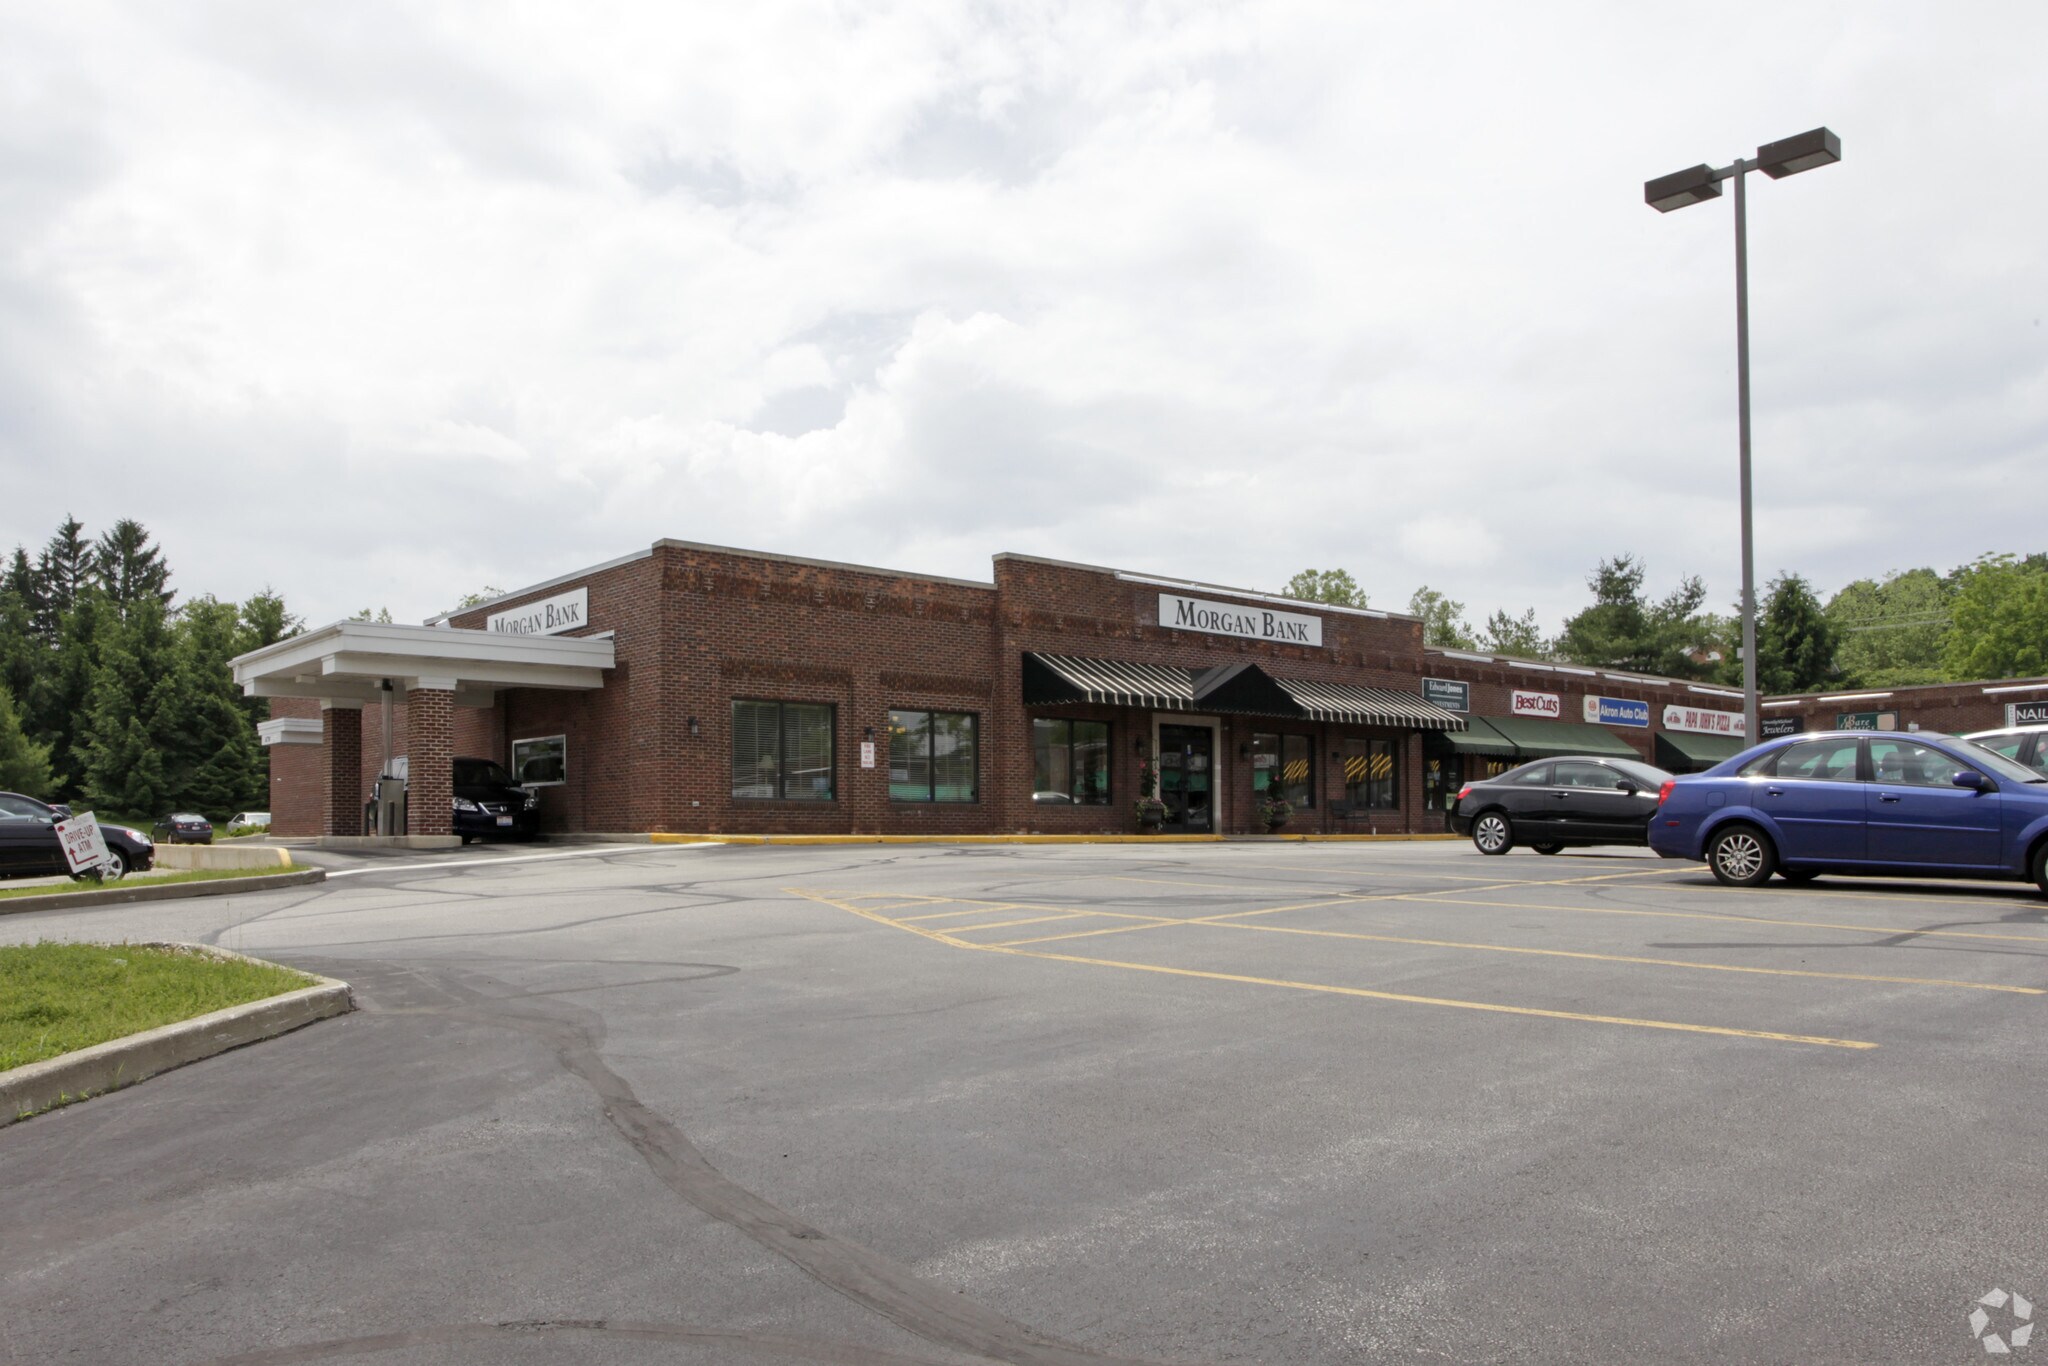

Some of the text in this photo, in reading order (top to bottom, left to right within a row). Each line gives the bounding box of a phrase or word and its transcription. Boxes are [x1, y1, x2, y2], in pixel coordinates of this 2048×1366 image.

[494, 603, 580, 635] MORGAN BANK
[1175, 599, 1309, 642] MORGAN BANK
[1600, 704, 1618, 717] Akron
[1619, 706, 1633, 719] Auto
[1634, 708, 1648, 720] Club
[1685, 710, 1698, 728] PAPA
[1699, 712, 1715, 731] JOHN'S
[1716, 713, 1731, 732] PIZZA
[1762, 723, 1795, 736] Jewelers
[65, 824, 94, 844] DRIVE-UP
[78, 839, 93, 853] ATM
